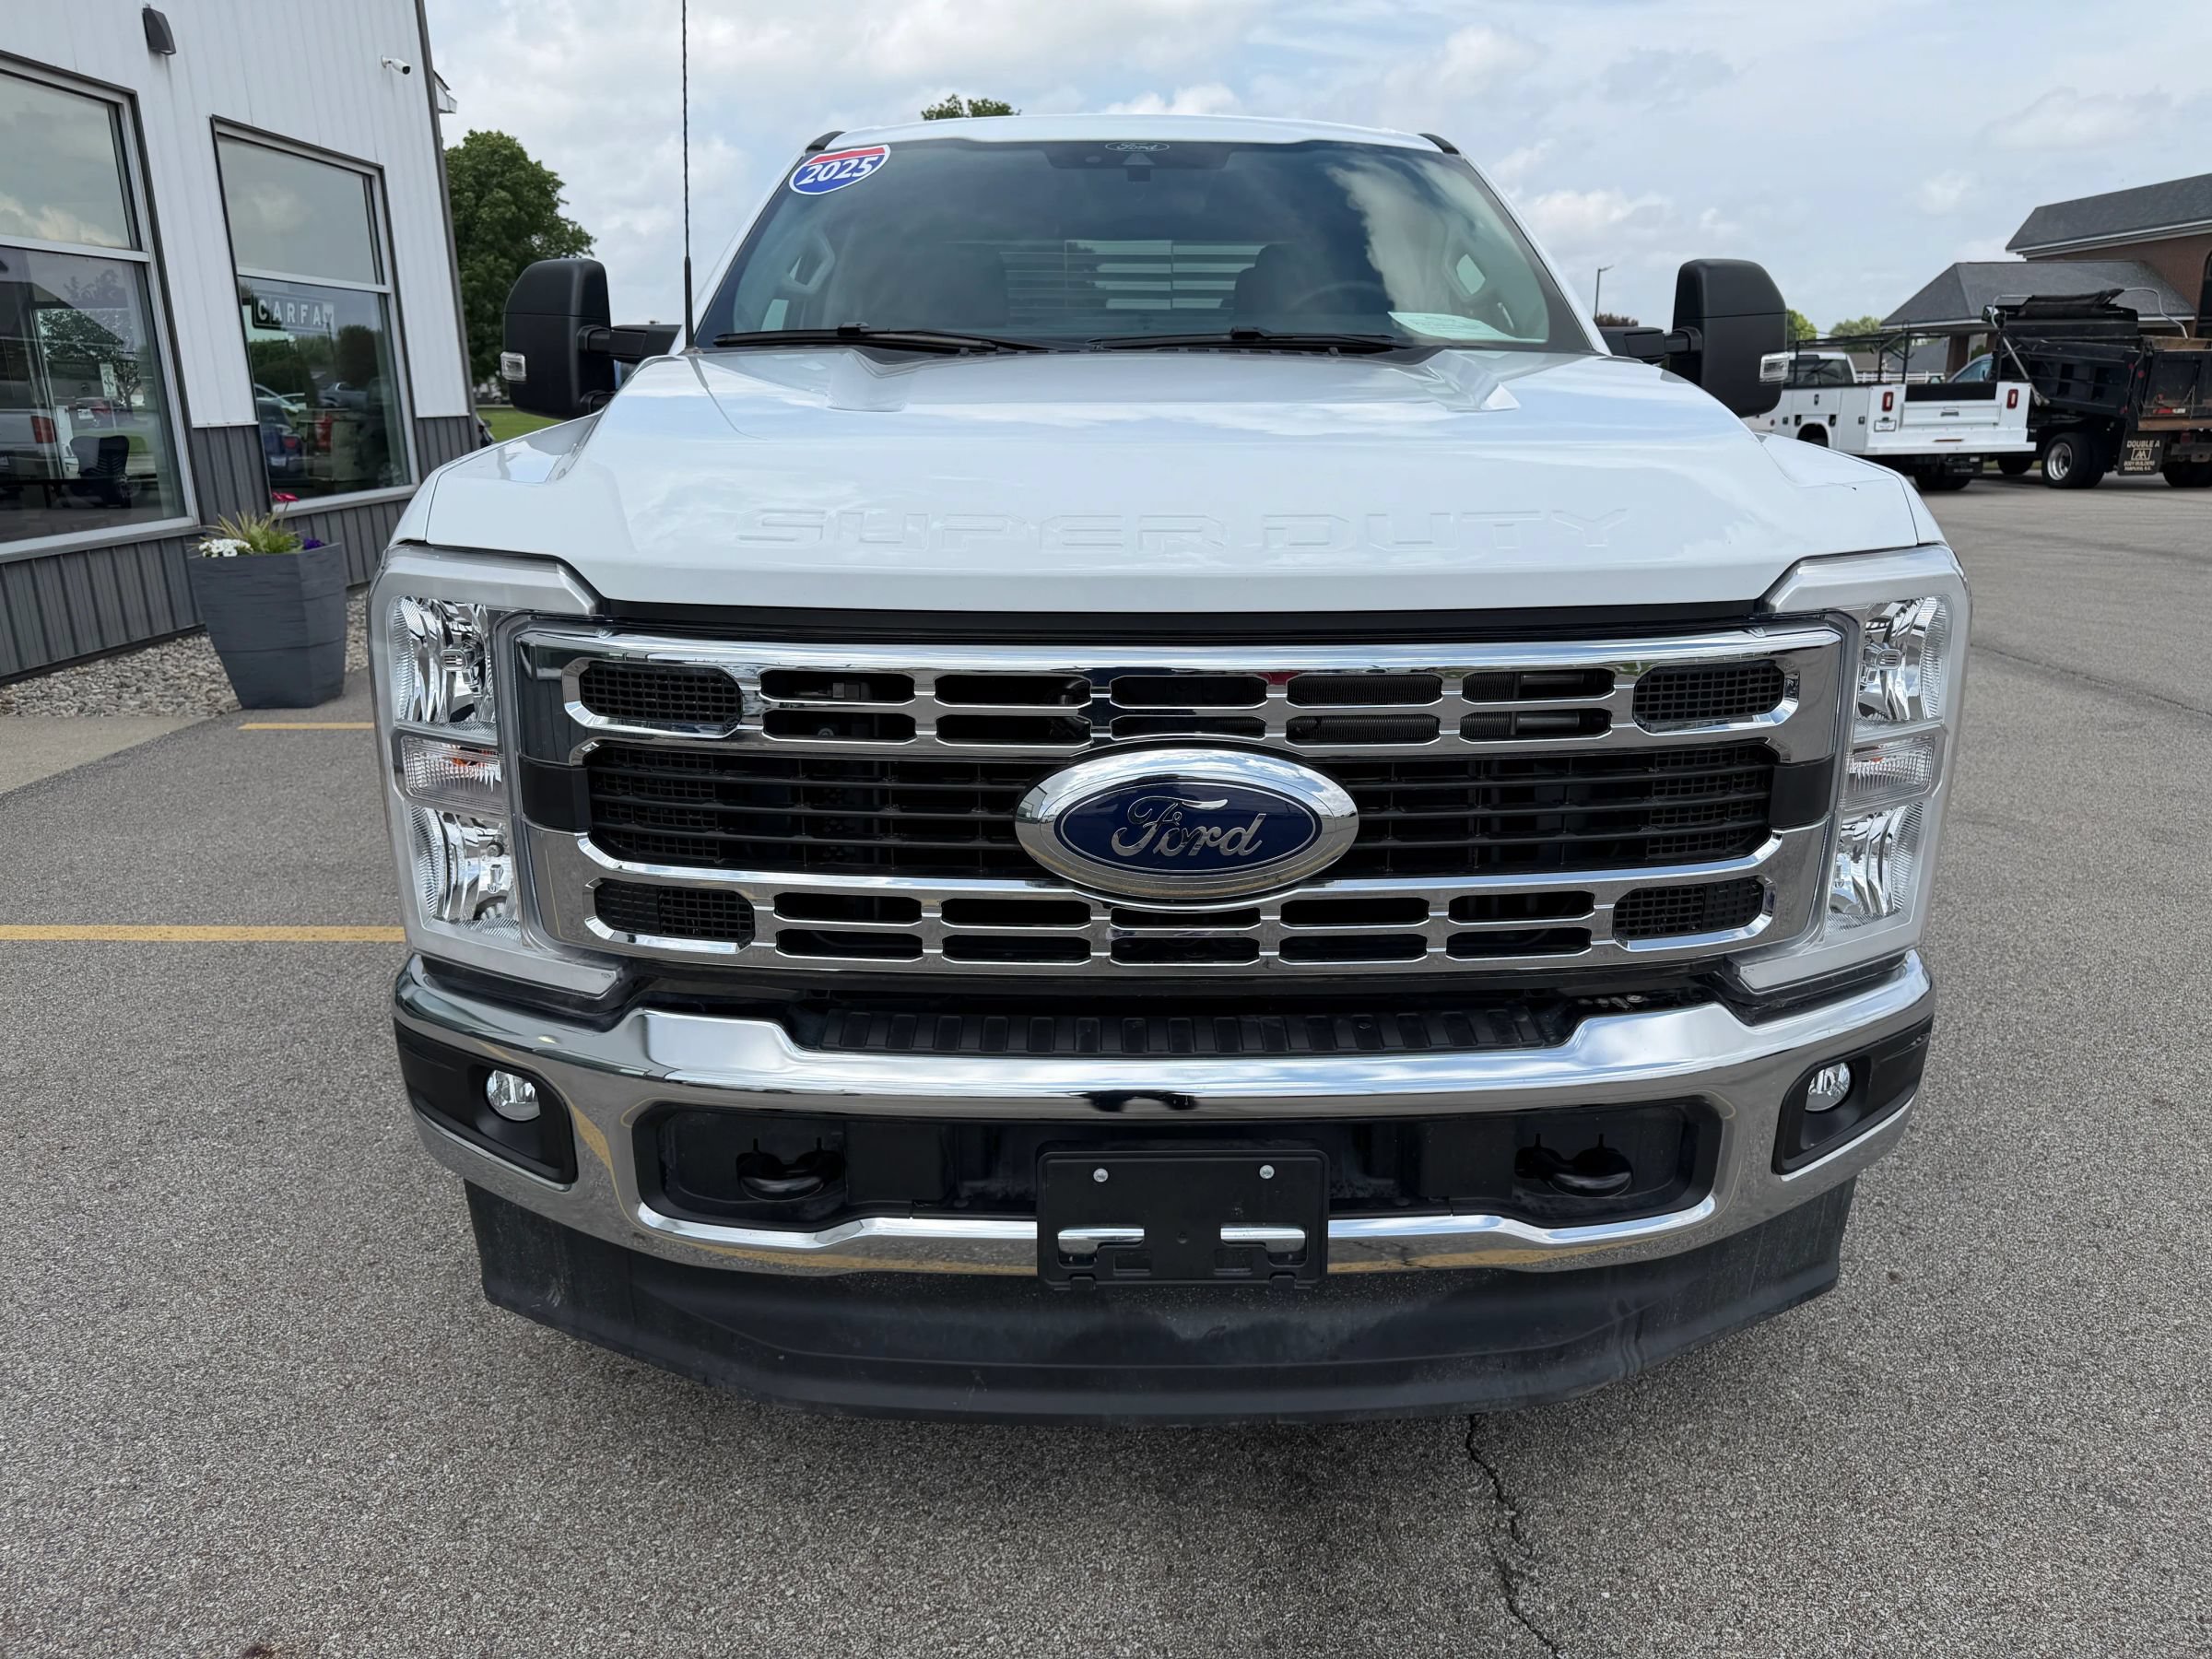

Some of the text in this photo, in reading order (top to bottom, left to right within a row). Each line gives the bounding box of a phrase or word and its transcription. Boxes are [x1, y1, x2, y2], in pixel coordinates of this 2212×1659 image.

[795, 156, 879, 186] 2025
[2126, 440, 2160, 448] DOUBLE A
[735, 508, 1630, 553] SUPER DUTY
[1111, 795, 1267, 857] Ford
